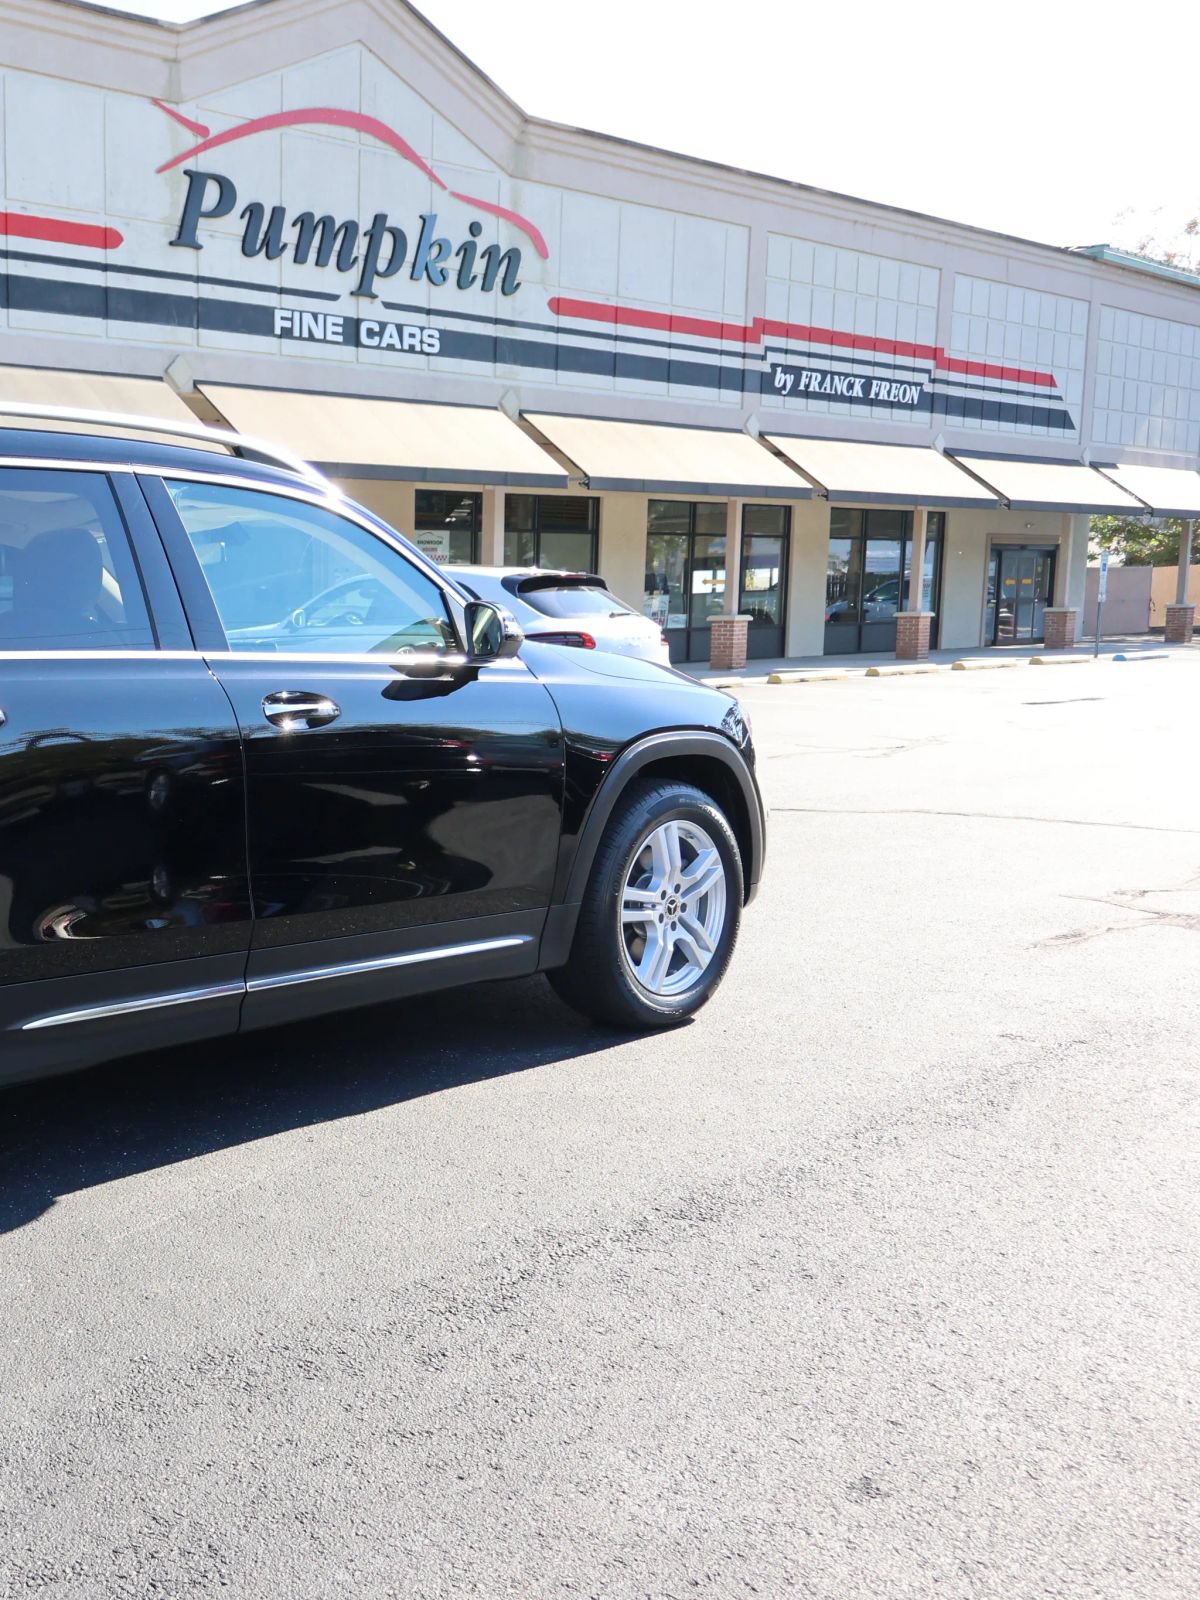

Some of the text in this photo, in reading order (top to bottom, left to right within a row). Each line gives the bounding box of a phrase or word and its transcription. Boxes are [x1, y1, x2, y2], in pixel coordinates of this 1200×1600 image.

[169, 169, 522, 298] Pumpkin
[274, 309, 440, 354] FINE CARS
[774, 366, 921, 405] by FRANCK FREON
